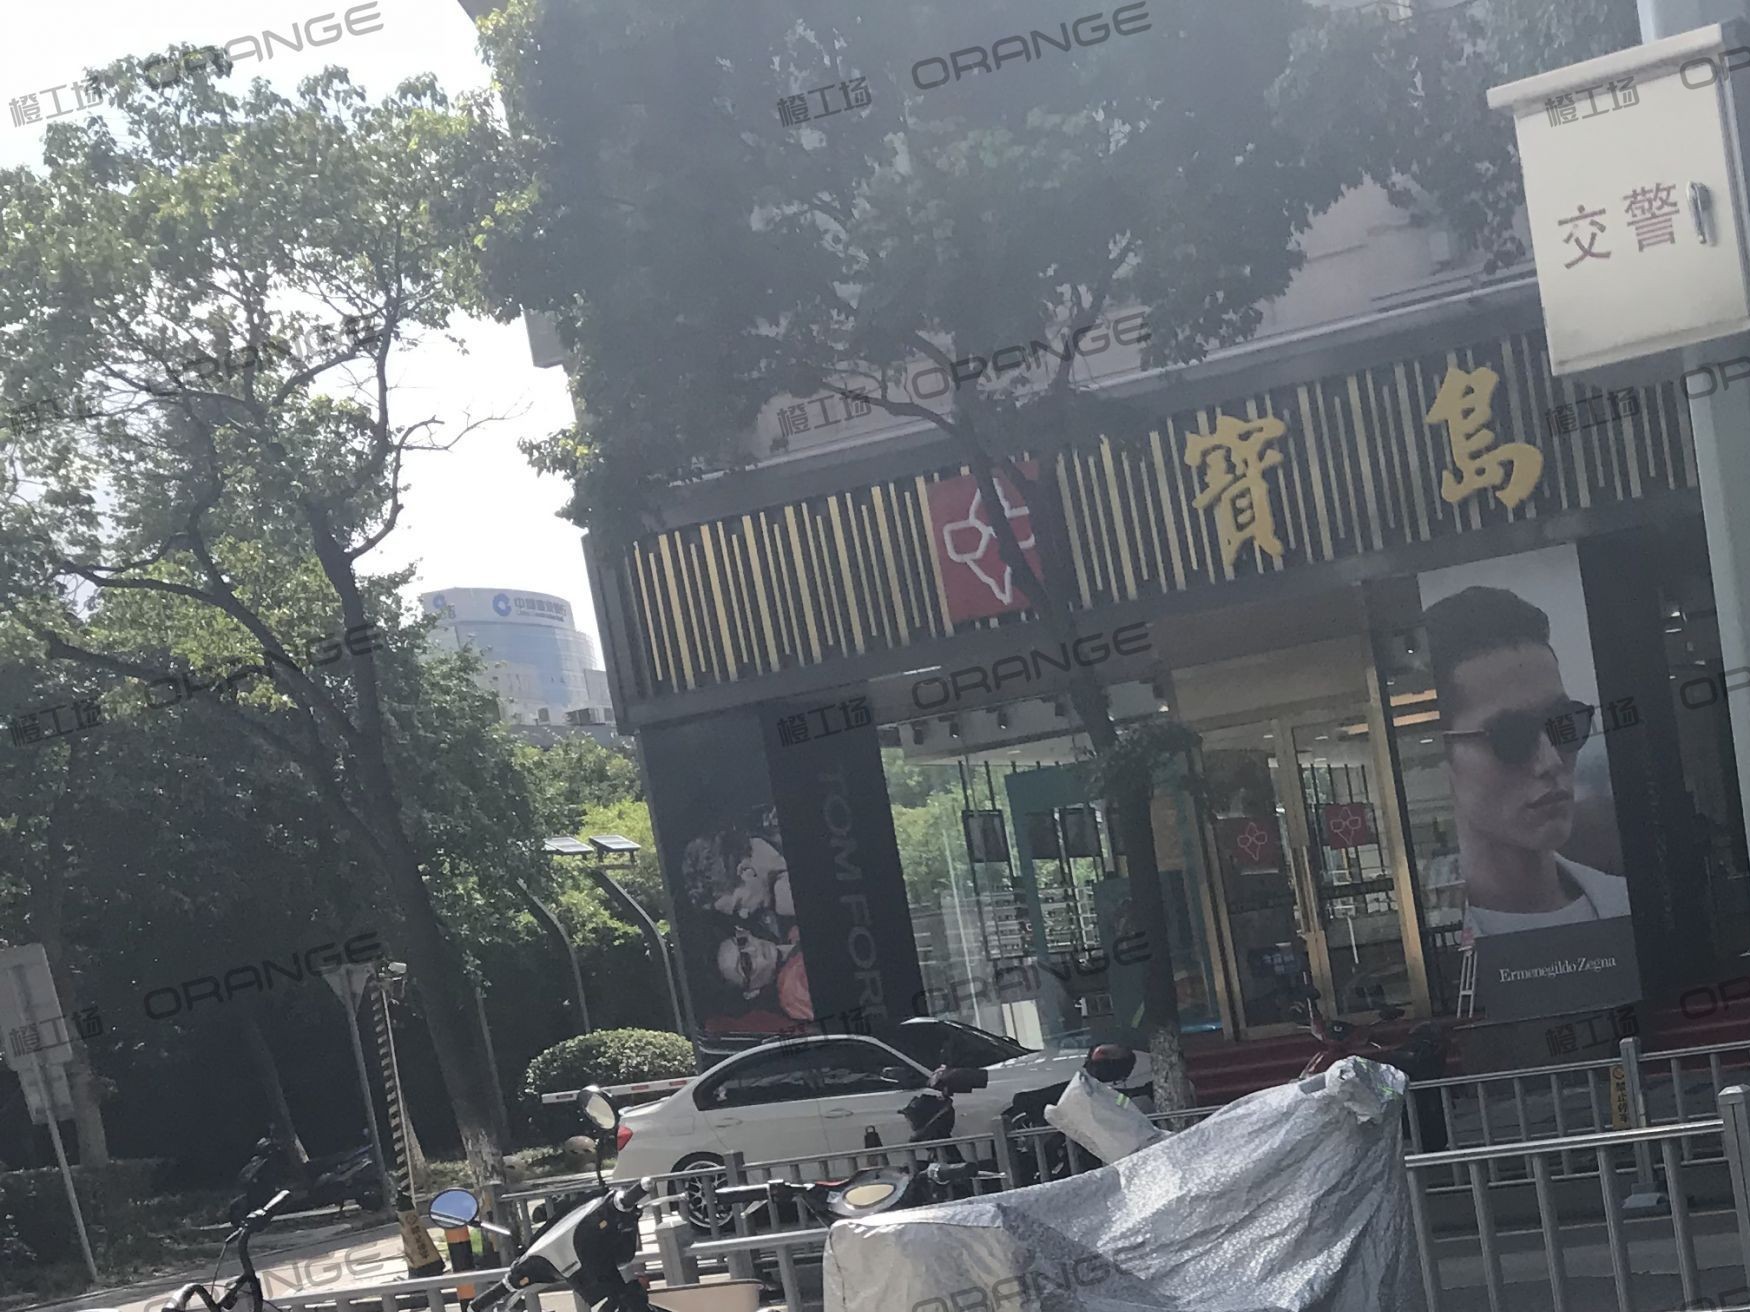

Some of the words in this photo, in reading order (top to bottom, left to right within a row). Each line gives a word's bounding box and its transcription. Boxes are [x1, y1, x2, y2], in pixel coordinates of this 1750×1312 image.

[1556, 182, 1681, 270] 交警
[818, 768, 864, 882] TOM
[839, 894, 888, 1021] FOR
[1499, 959, 1577, 983] Ermenegildo
[1577, 955, 1617, 975] Zegna
